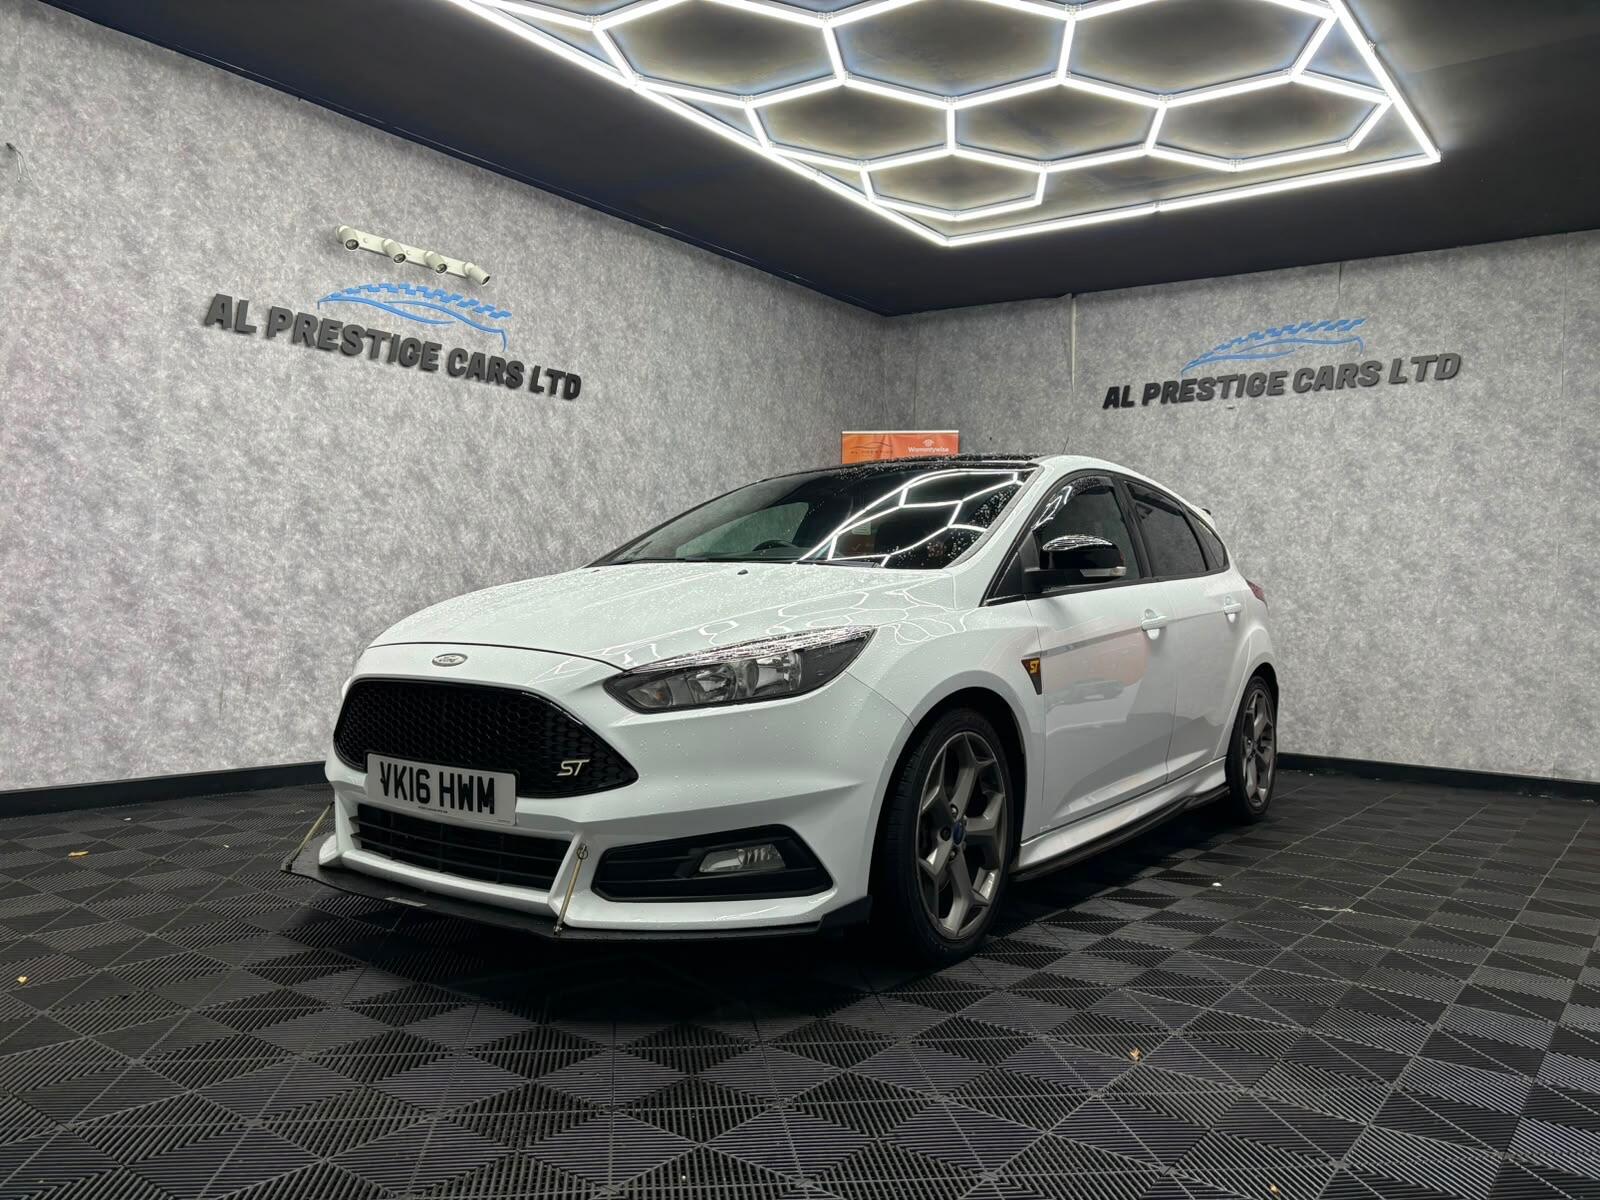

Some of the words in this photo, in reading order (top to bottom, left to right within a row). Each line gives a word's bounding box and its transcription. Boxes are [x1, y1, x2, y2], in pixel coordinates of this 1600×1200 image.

[205, 294, 257, 334] AL
[266, 305, 443, 372] PRESTIGE
[447, 347, 525, 389] CARS
[530, 365, 582, 400] LTD
[1102, 385, 1136, 411] AL
[1142, 370, 1288, 406] PRESTIGE
[1292, 360, 1382, 394] CARS
[1388, 352, 1462, 385] LTD
[380, 761, 431, 804] VK16
[439, 771, 495, 815] HWM
[556, 759, 591, 777] ST
